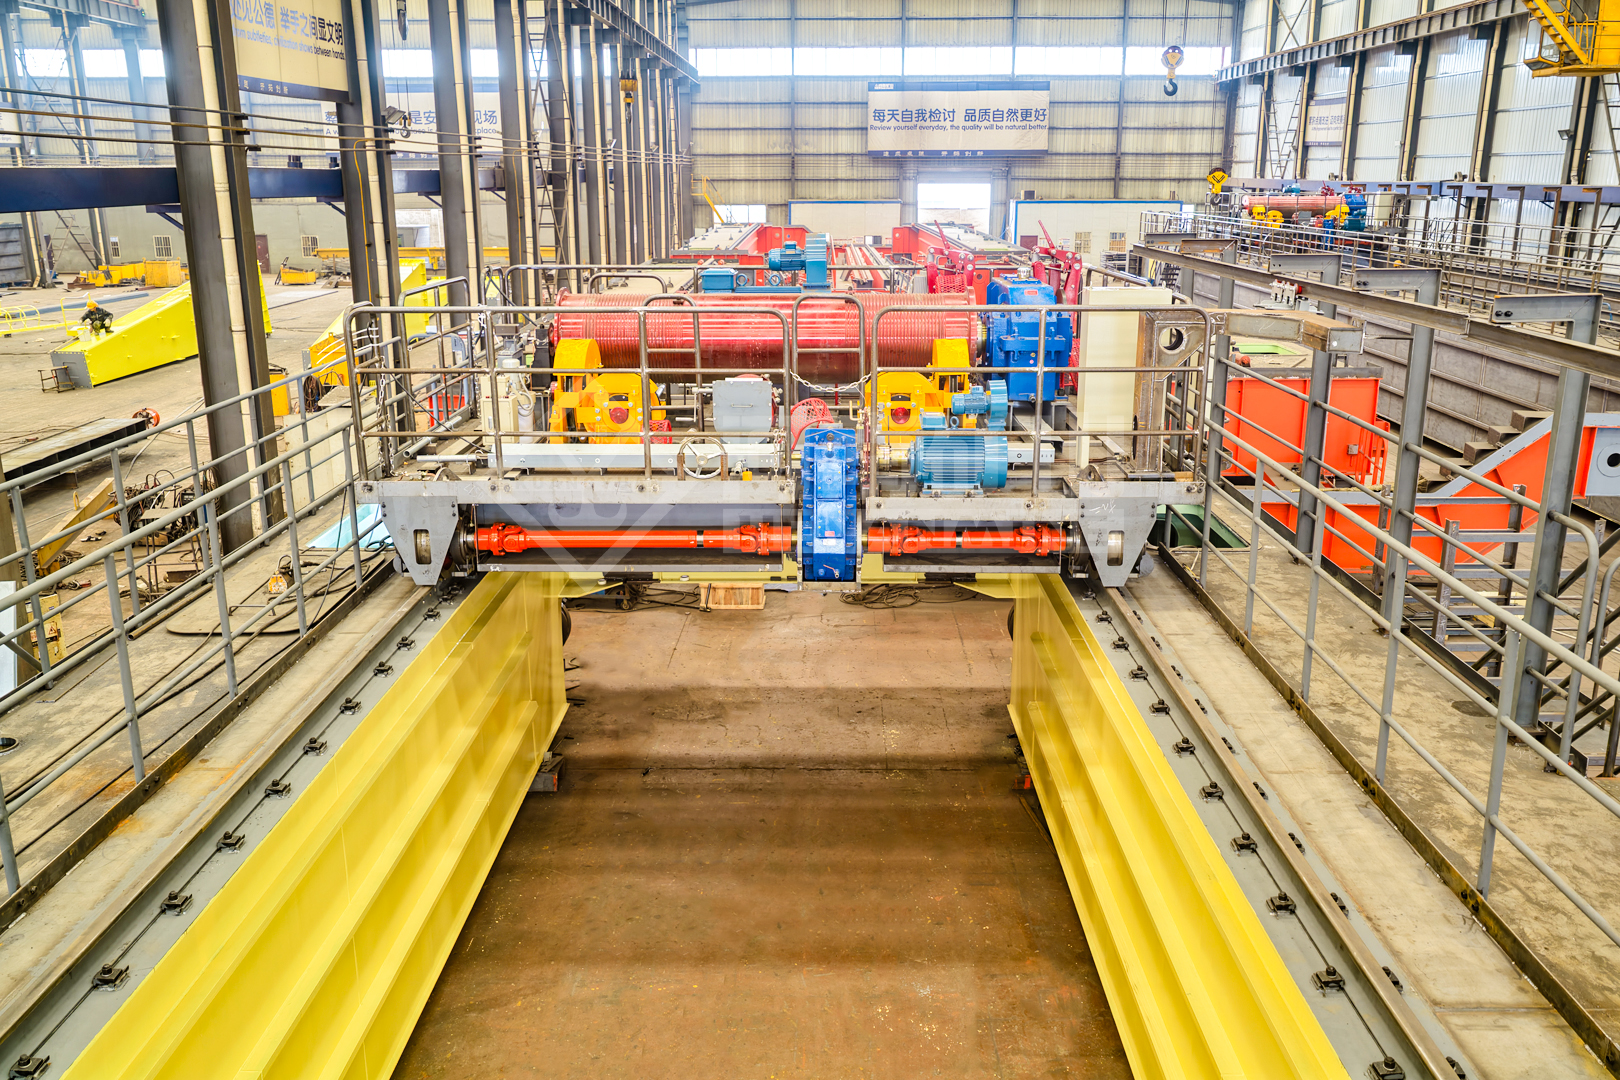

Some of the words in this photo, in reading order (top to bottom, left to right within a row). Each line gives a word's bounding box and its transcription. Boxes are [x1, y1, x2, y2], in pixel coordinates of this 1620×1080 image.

[280, 6, 344, 46] 举手之间显文明
[872, 108, 956, 123] 每天自我检讨
[963, 108, 1047, 123] 品质自然更好
[893, 124, 917, 132] yourself
[962, 124, 982, 132] quality
